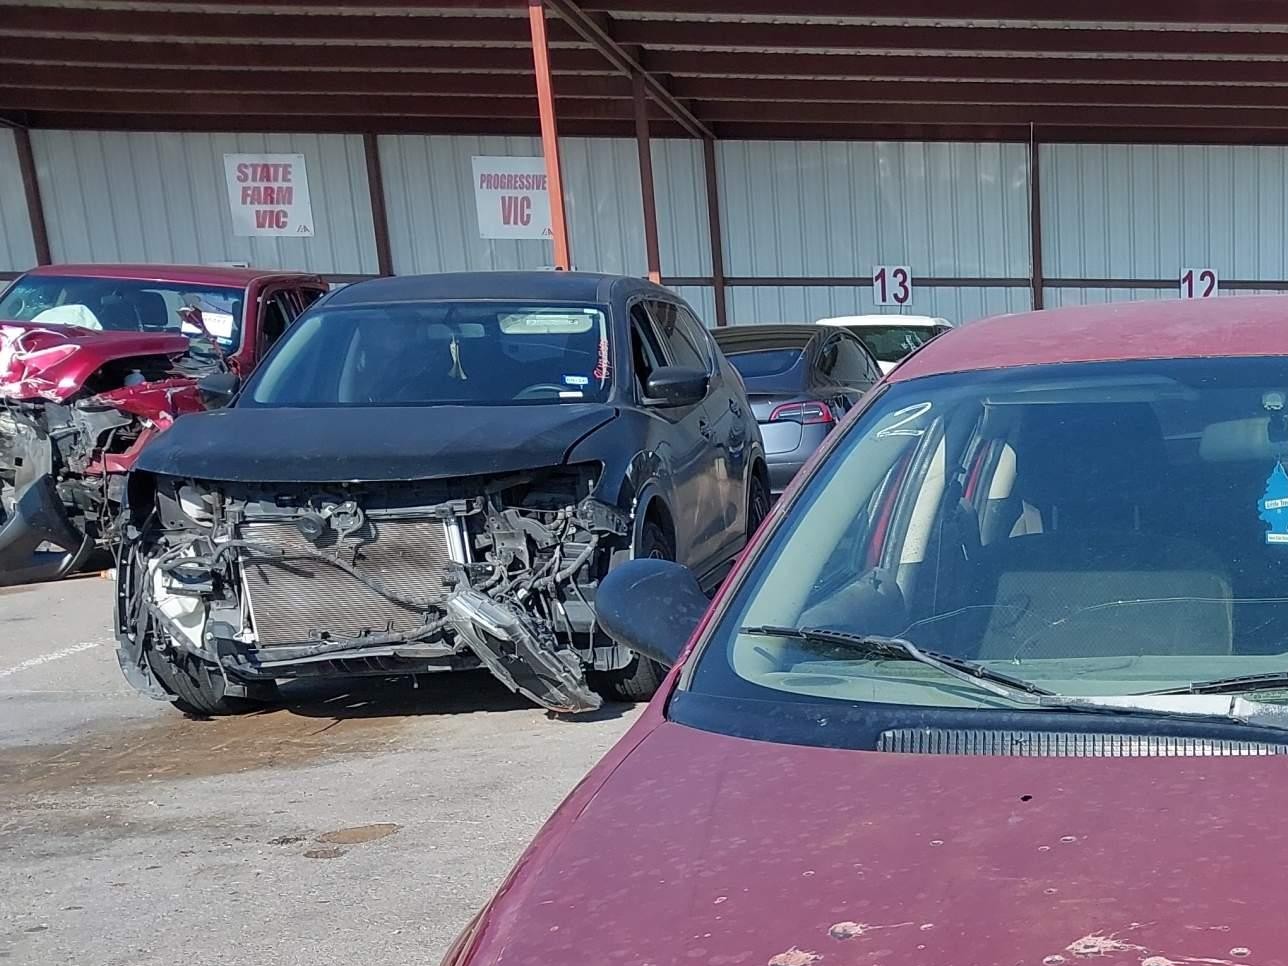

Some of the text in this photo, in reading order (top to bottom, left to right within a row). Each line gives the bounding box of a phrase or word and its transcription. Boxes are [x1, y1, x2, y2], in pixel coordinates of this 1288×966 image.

[236, 163, 292, 183] STATE
[479, 173, 548, 191] PROGRESSIVE
[241, 186, 293, 206] FARM
[255, 209, 289, 229] VIC
[500, 195, 531, 226] VIC
[874, 267, 910, 304] 13
[1182, 269, 1216, 299] 12
